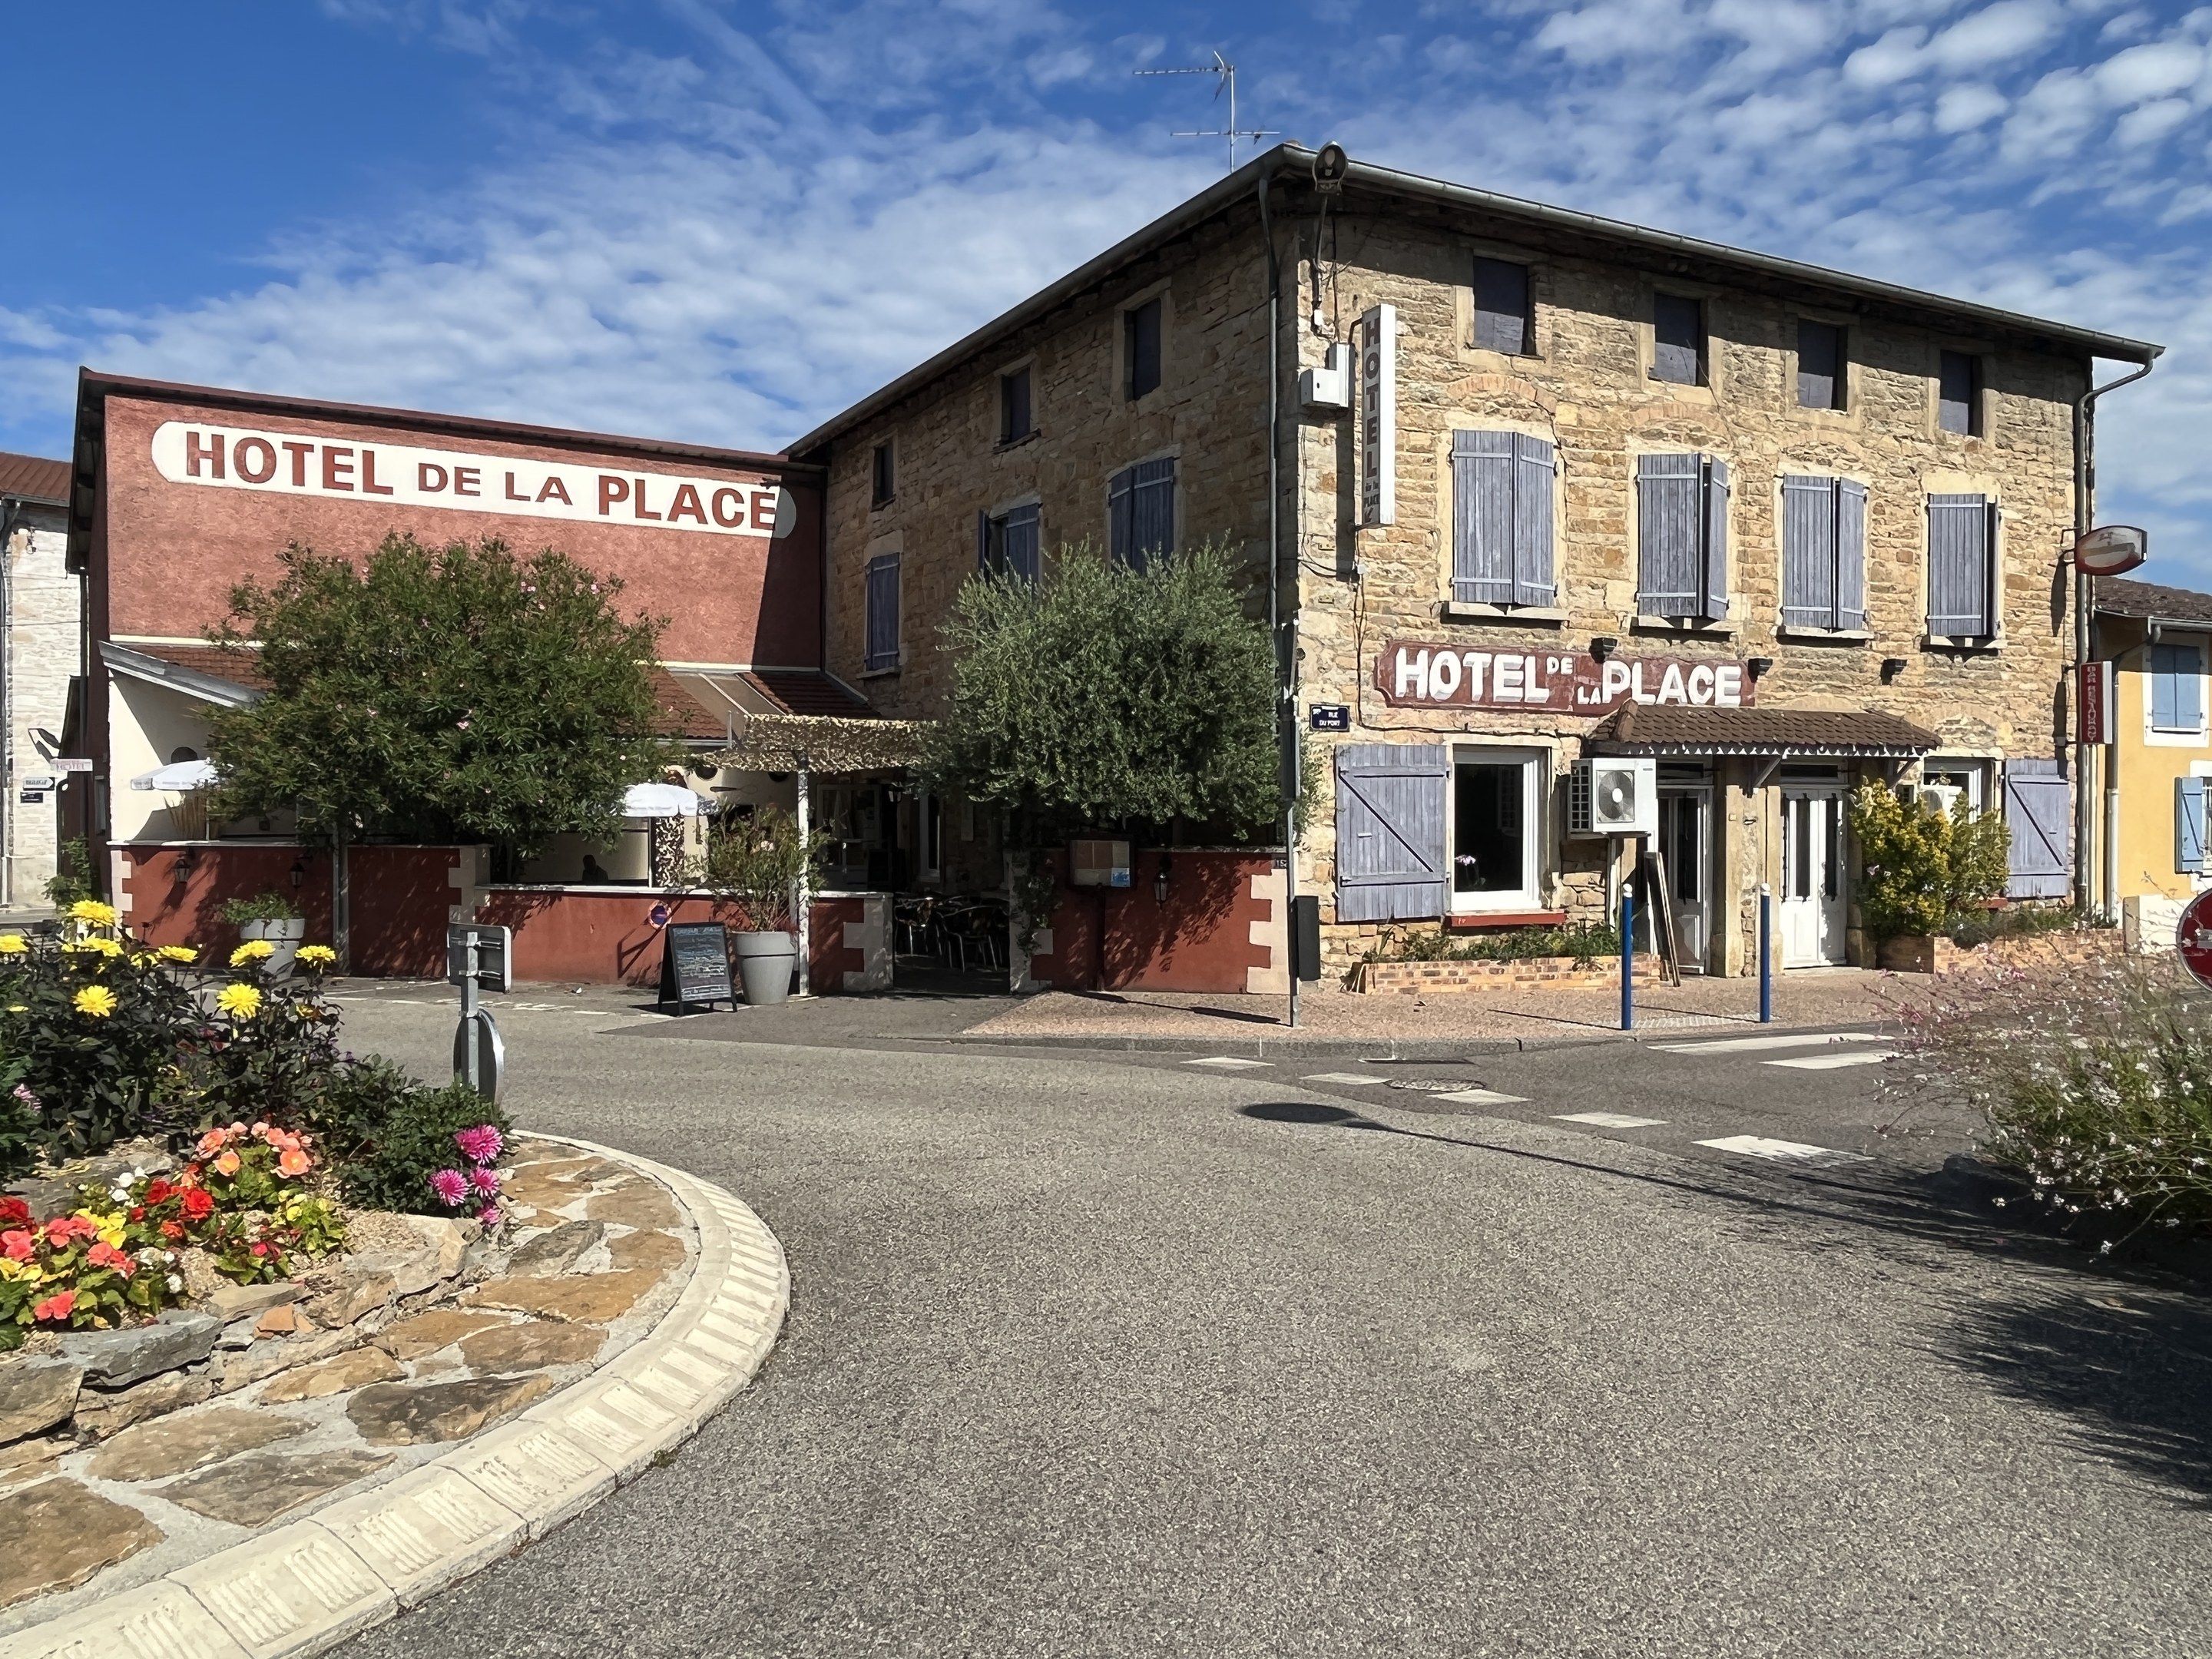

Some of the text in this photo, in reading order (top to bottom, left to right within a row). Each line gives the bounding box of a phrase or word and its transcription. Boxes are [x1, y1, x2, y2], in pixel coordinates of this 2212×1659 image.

[1366, 318, 1380, 478] HOTEL
[187, 432, 777, 531] HOTEL DE LA PLACE
[1395, 647, 1742, 707] HOTEL DE LA PLACE
